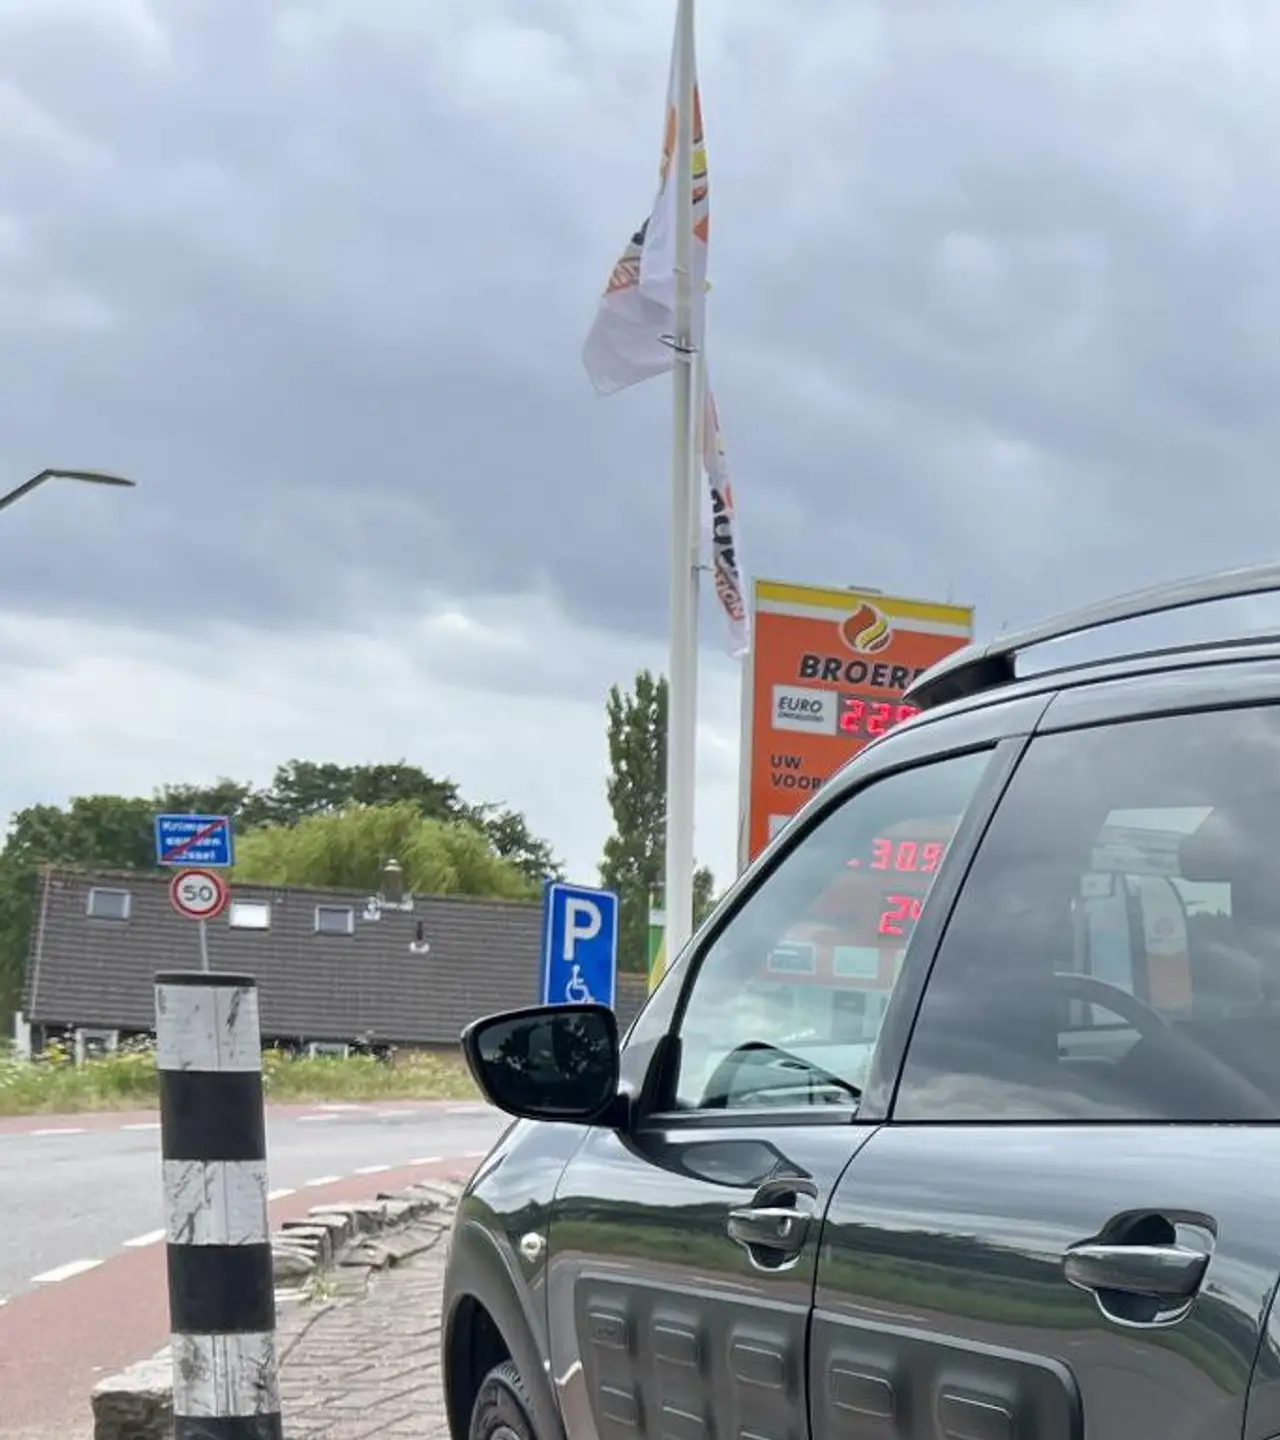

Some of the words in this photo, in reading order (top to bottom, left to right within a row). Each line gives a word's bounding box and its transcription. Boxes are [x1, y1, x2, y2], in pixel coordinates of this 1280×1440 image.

[778, 695, 823, 714] EURO
[771, 753, 801, 770] UW
[182, 885, 213, 902] 50
[563, 897, 602, 961] P
